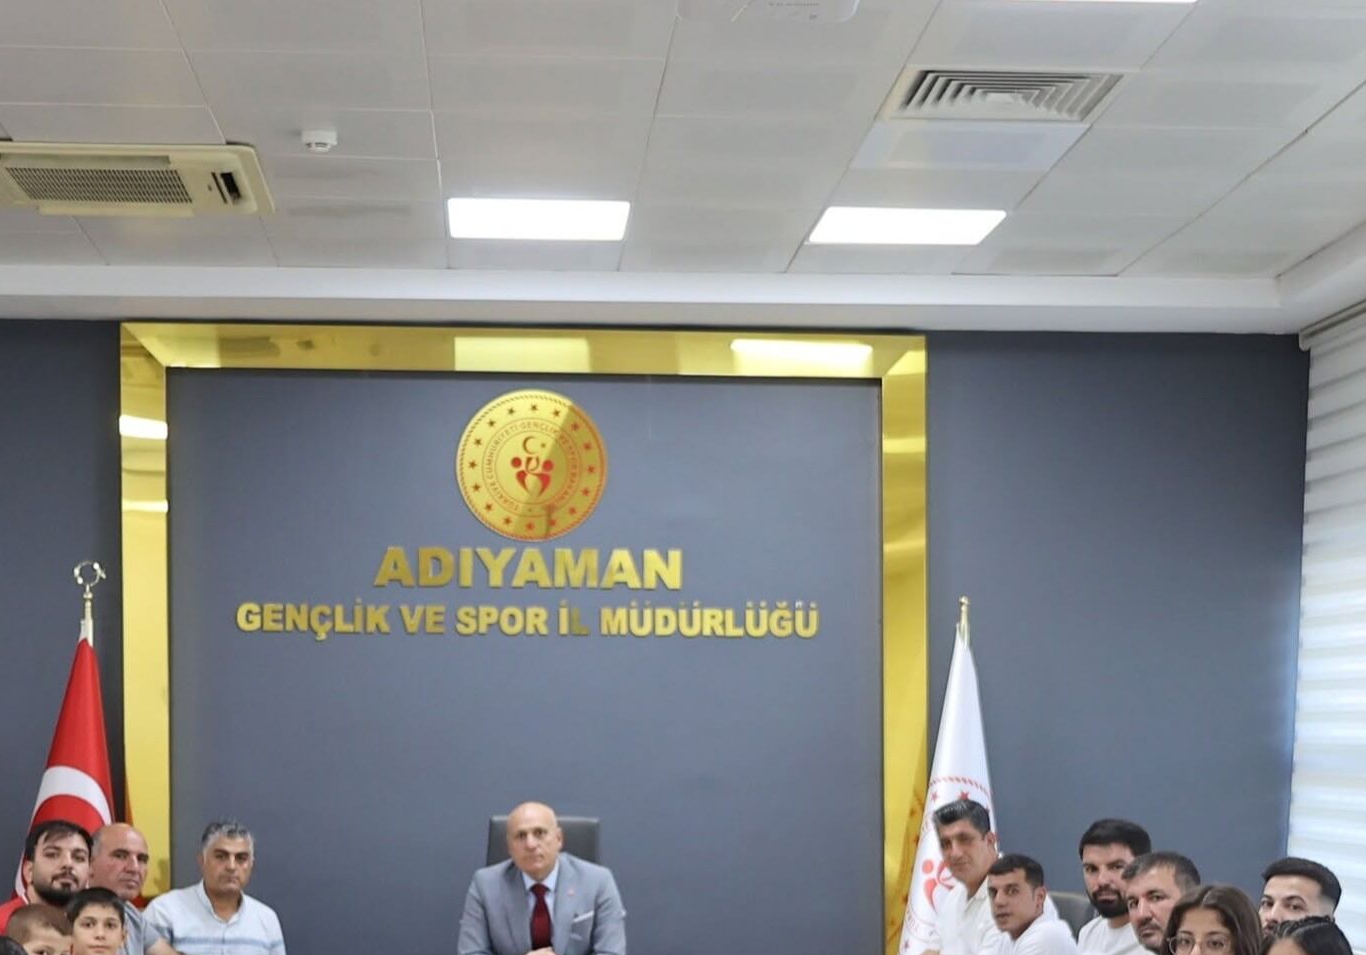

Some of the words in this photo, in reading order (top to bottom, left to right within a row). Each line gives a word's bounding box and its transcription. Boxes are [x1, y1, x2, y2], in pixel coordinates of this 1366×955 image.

[373, 546, 682, 590] ADIYAMAN
[236, 598, 390, 640] GENÇLİK
[400, 604, 446, 634] VE
[456, 605, 549, 635] SPOR
[558, 600, 590, 635] İL
[600, 600, 819, 637] MÜDÜRLÜĞÜ
